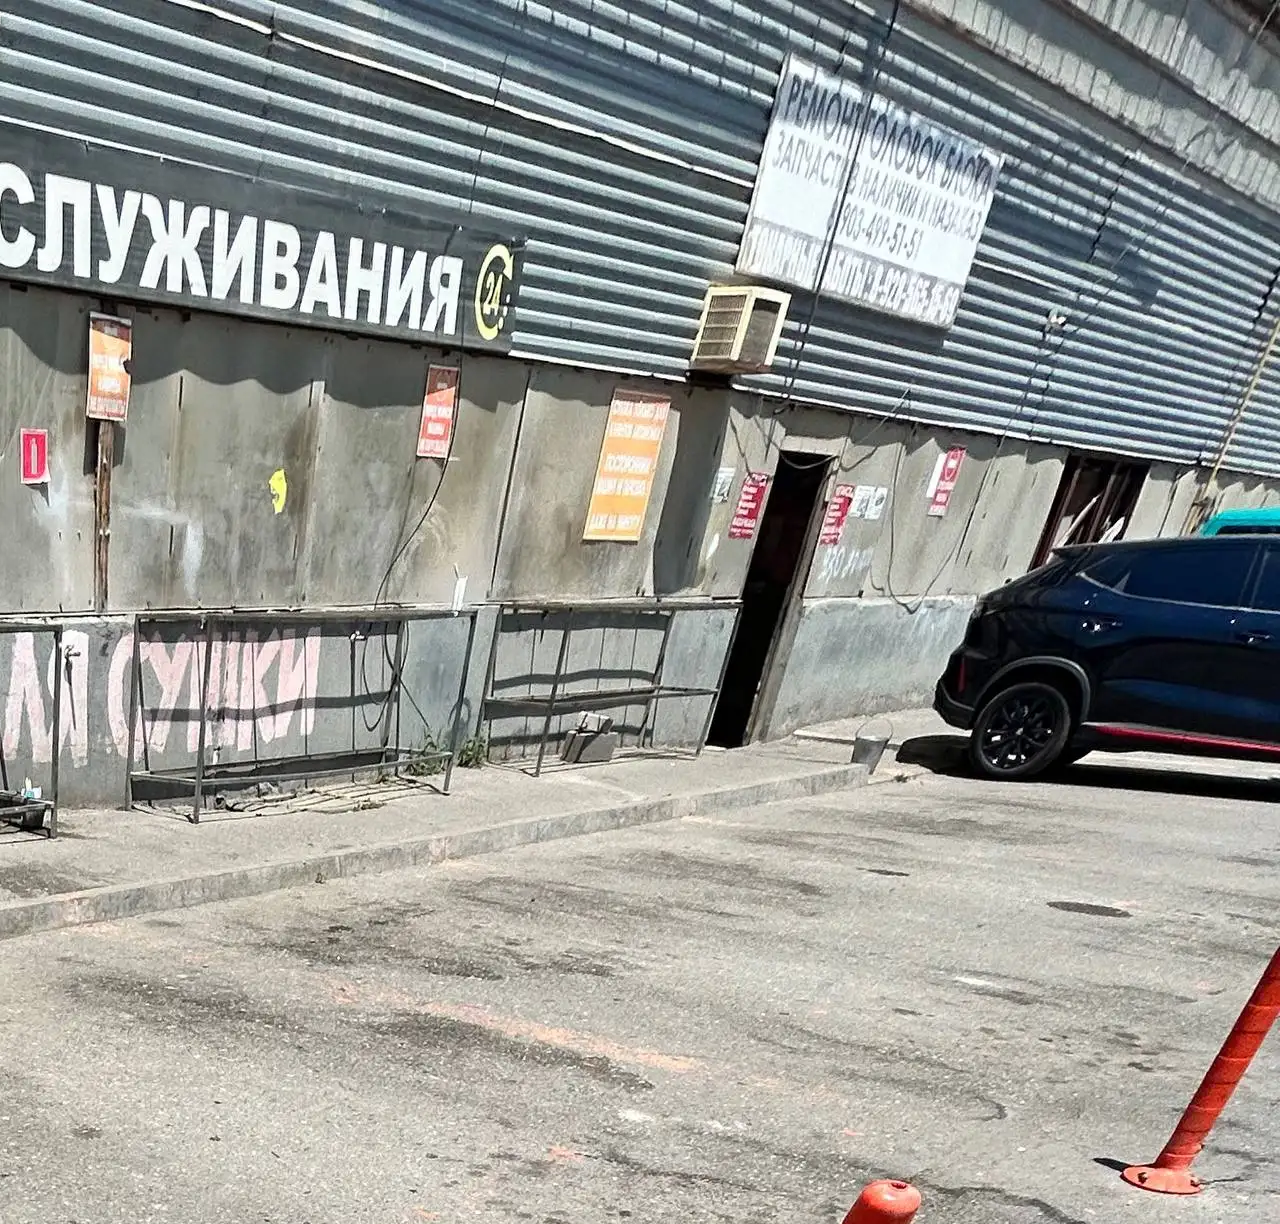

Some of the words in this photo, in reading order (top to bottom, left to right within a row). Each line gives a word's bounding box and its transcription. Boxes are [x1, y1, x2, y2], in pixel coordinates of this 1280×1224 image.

[770, 128, 850, 193] ЗАПЧАСТИ
[857, 163, 922, 219] НАЛИЧИИ
[781, 72, 865, 152] РЕМОНТ
[859, 106, 945, 185] ГОЛОВОК
[938, 140, 997, 206] БЛОКА
[108, 626, 320, 760] СУШКИ
